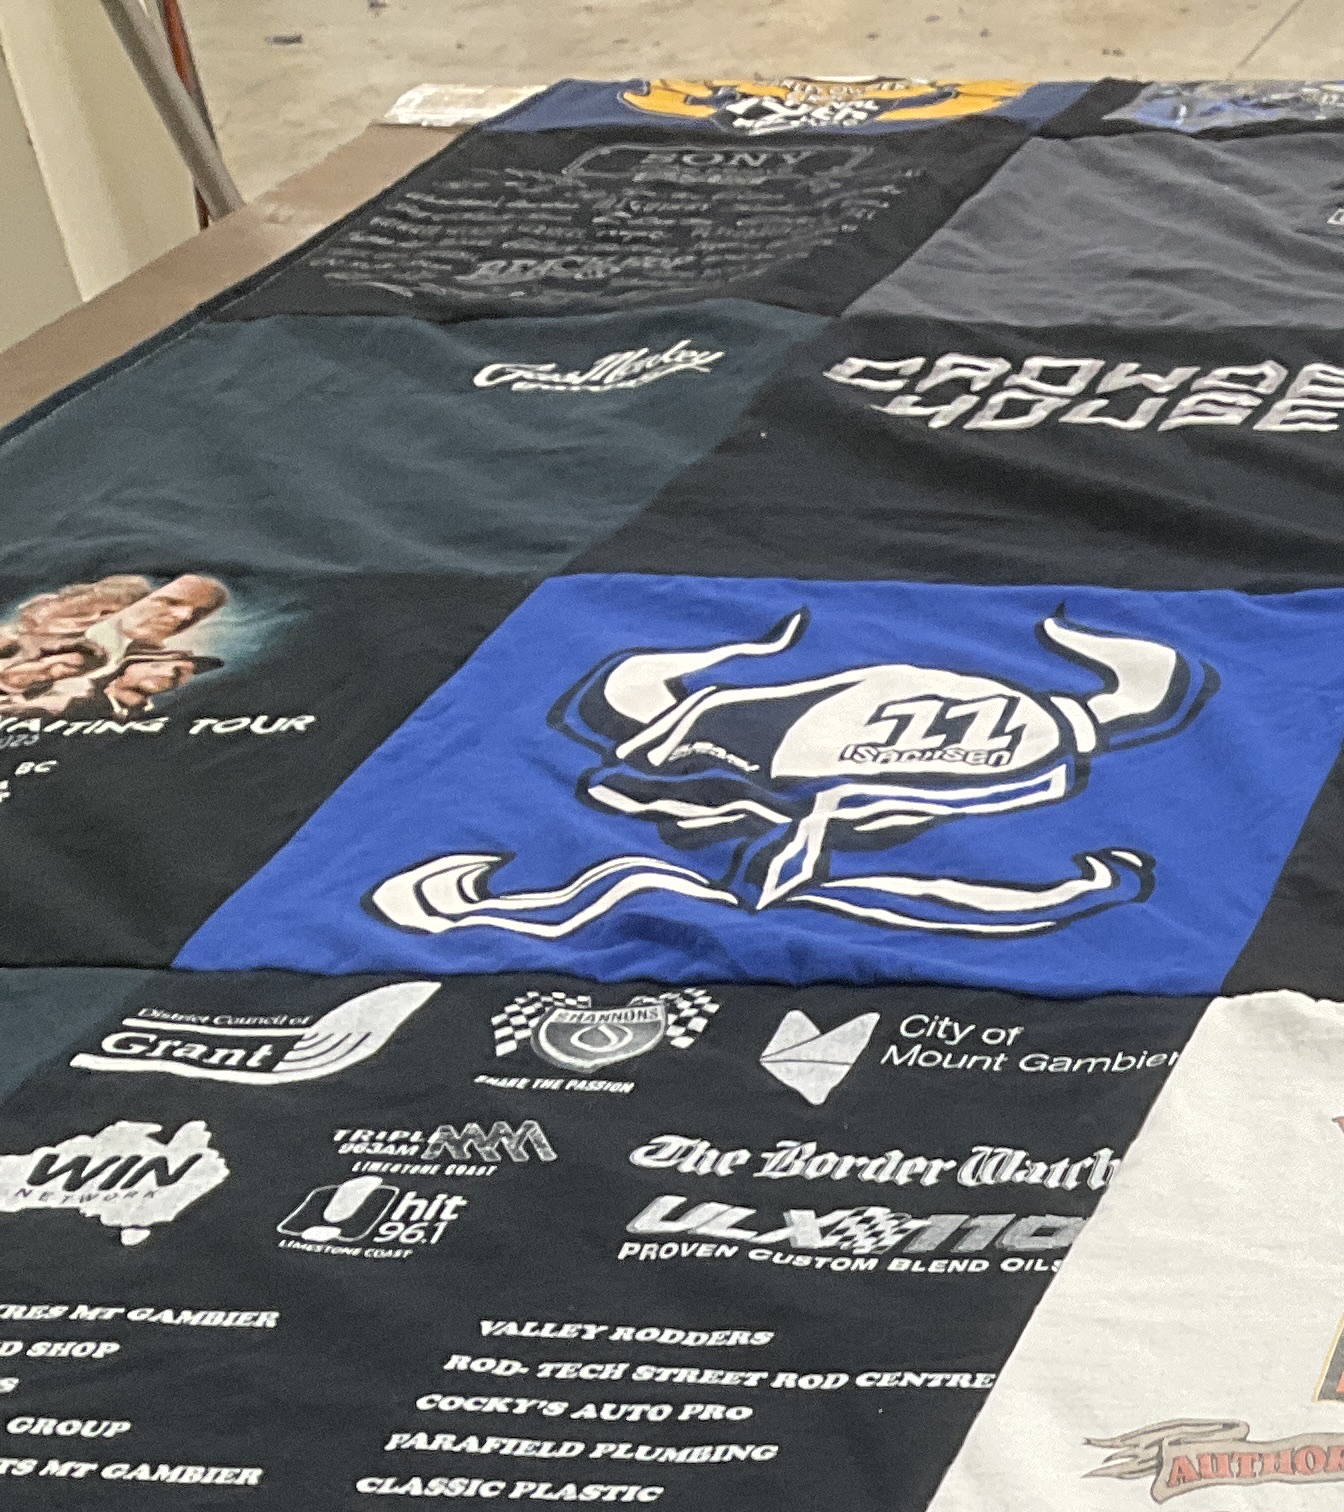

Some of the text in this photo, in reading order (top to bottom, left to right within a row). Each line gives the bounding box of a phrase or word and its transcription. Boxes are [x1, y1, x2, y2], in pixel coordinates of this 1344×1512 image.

[188, 715, 315, 736] TOUR
[14, 760, 57, 777] BC
[137, 1006, 311, 1027] District Council of
[898, 1013, 1024, 1048] City of
[101, 1029, 277, 1071] Grant
[880, 1045, 1179, 1074] Mount Gambier
[532, 1078, 635, 1094] THE PASSION
[26, 1153, 203, 1192] WIN
[628, 1133, 1122, 1190] The Border Watch
[14, 1187, 158, 1204] NETWORK
[391, 1190, 468, 1222] hit
[374, 1222, 446, 1245] 96.1
[278, 1238, 413, 1260] LIMESTONE COAST
[617, 1241, 990, 1273] PROVEN CUSTOM BLEND
[68, 1304, 281, 1329] MT GAMBIER
[478, 1319, 774, 1348] VALLEY RODDERS
[26, 1340, 121, 1359] SHOP
[537, 1360, 996, 1391] TECH STREET ROD CENTRE
[414, 1393, 753, 1423] COCKY'S AUTO PRO
[6, 1416, 132, 1439] GROUP
[383, 1431, 780, 1466] PARAFIELD PLUMBING
[39, 1459, 264, 1486] MT GAMBIER
[355, 1474, 663, 1504] CLASSIC PLASTIC
